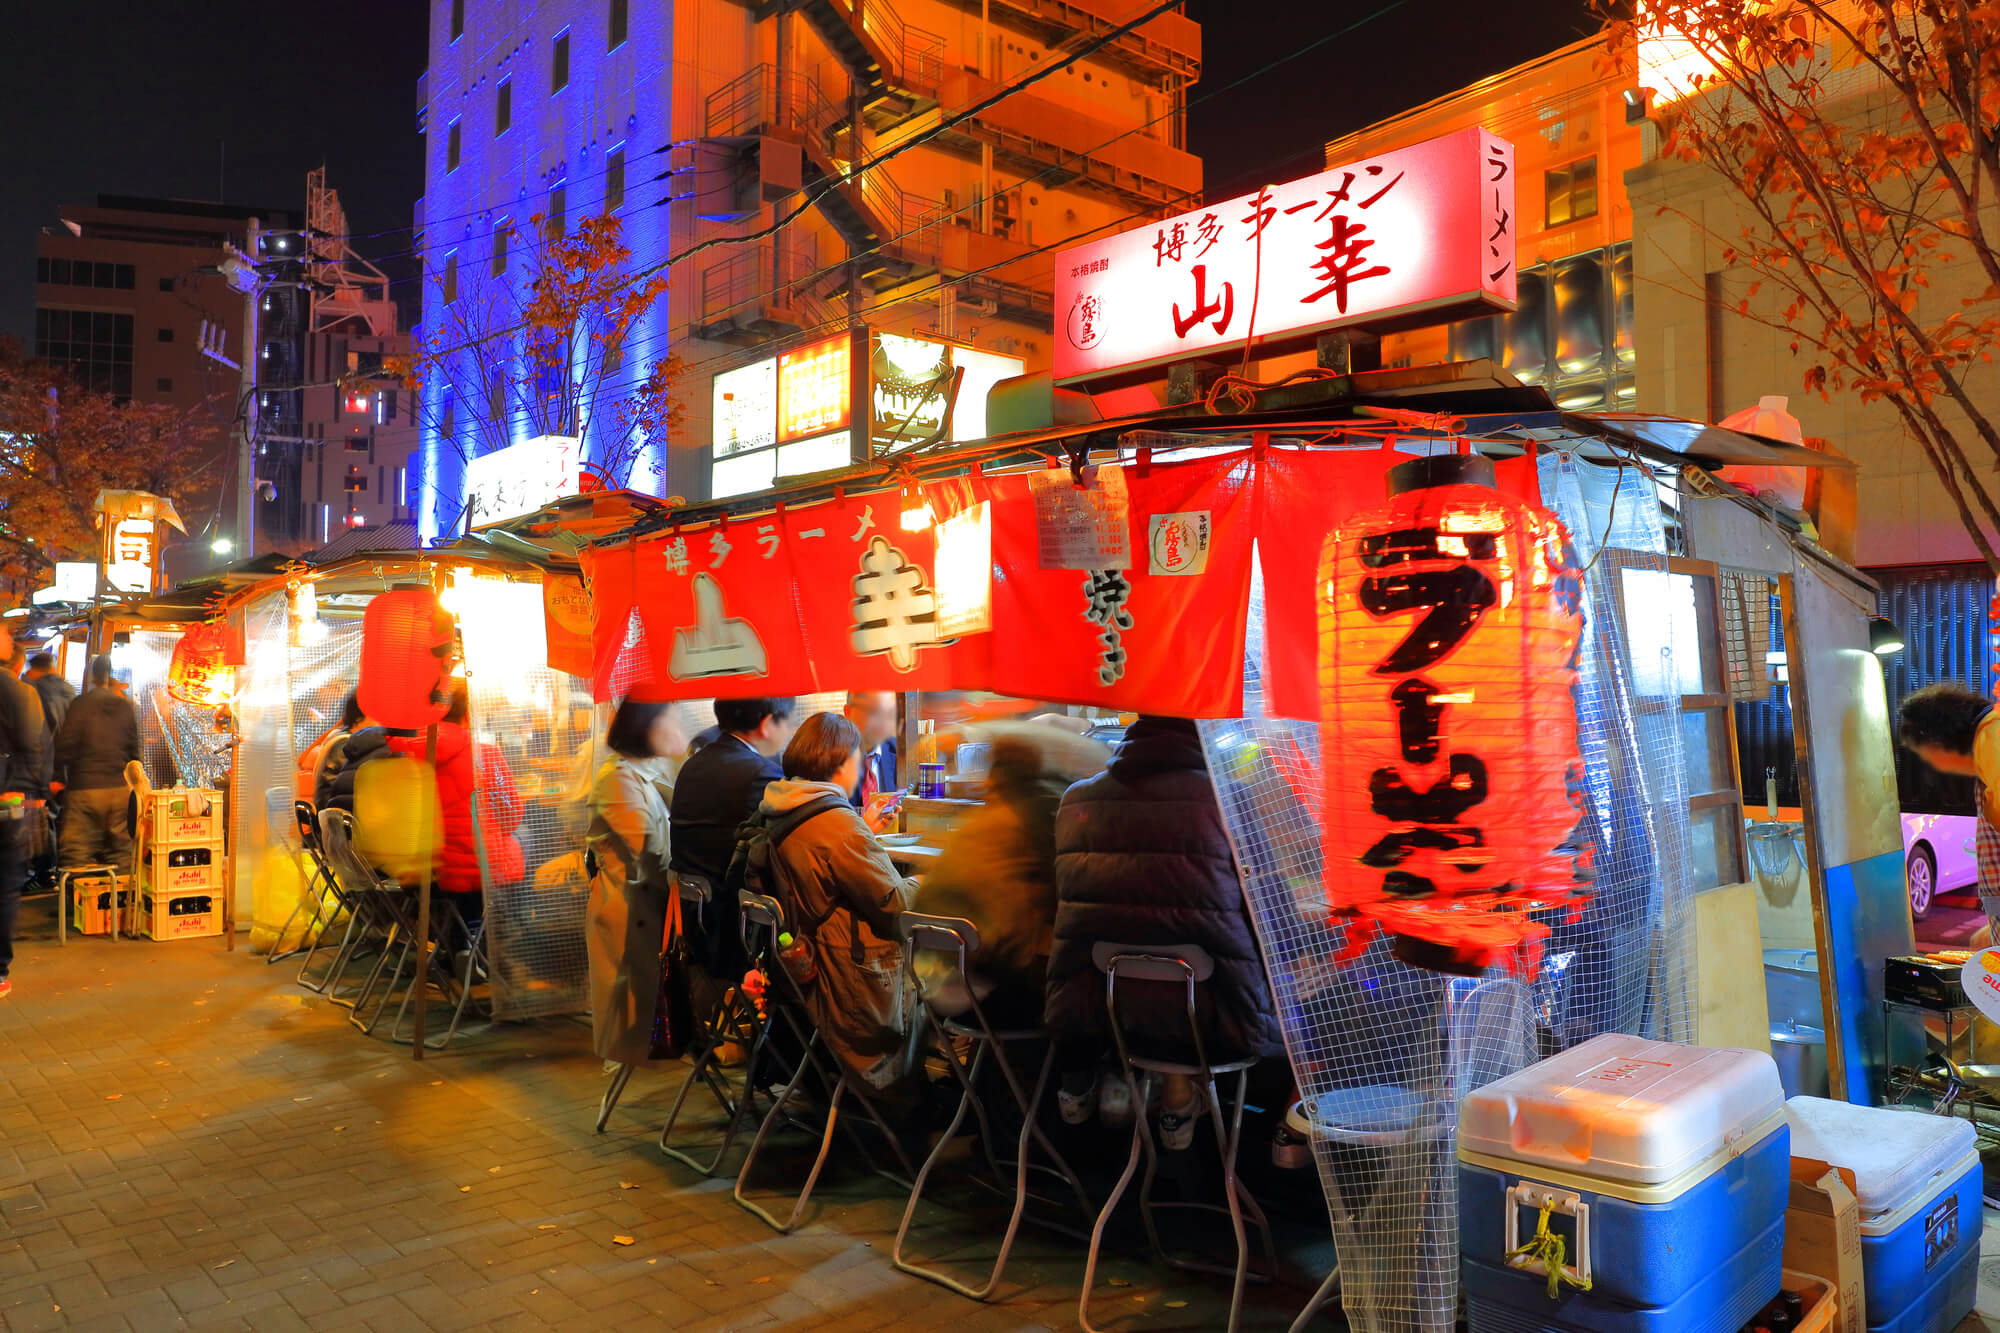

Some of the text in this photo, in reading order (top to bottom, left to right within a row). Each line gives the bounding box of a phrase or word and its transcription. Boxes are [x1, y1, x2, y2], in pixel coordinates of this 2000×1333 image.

[1152, 166, 1405, 267] 博多ラーメン
[1487, 145, 1511, 282] ラーメン
[1071, 258, 1109, 278] 本格焼酎
[556, 442, 570, 500] ラーメ
[663, 504, 877, 576] 博多ラーメ
[179, 822, 201, 831] Asahi
[179, 871, 201, 880] Asahi
[179, 918, 201, 928] Asahi
